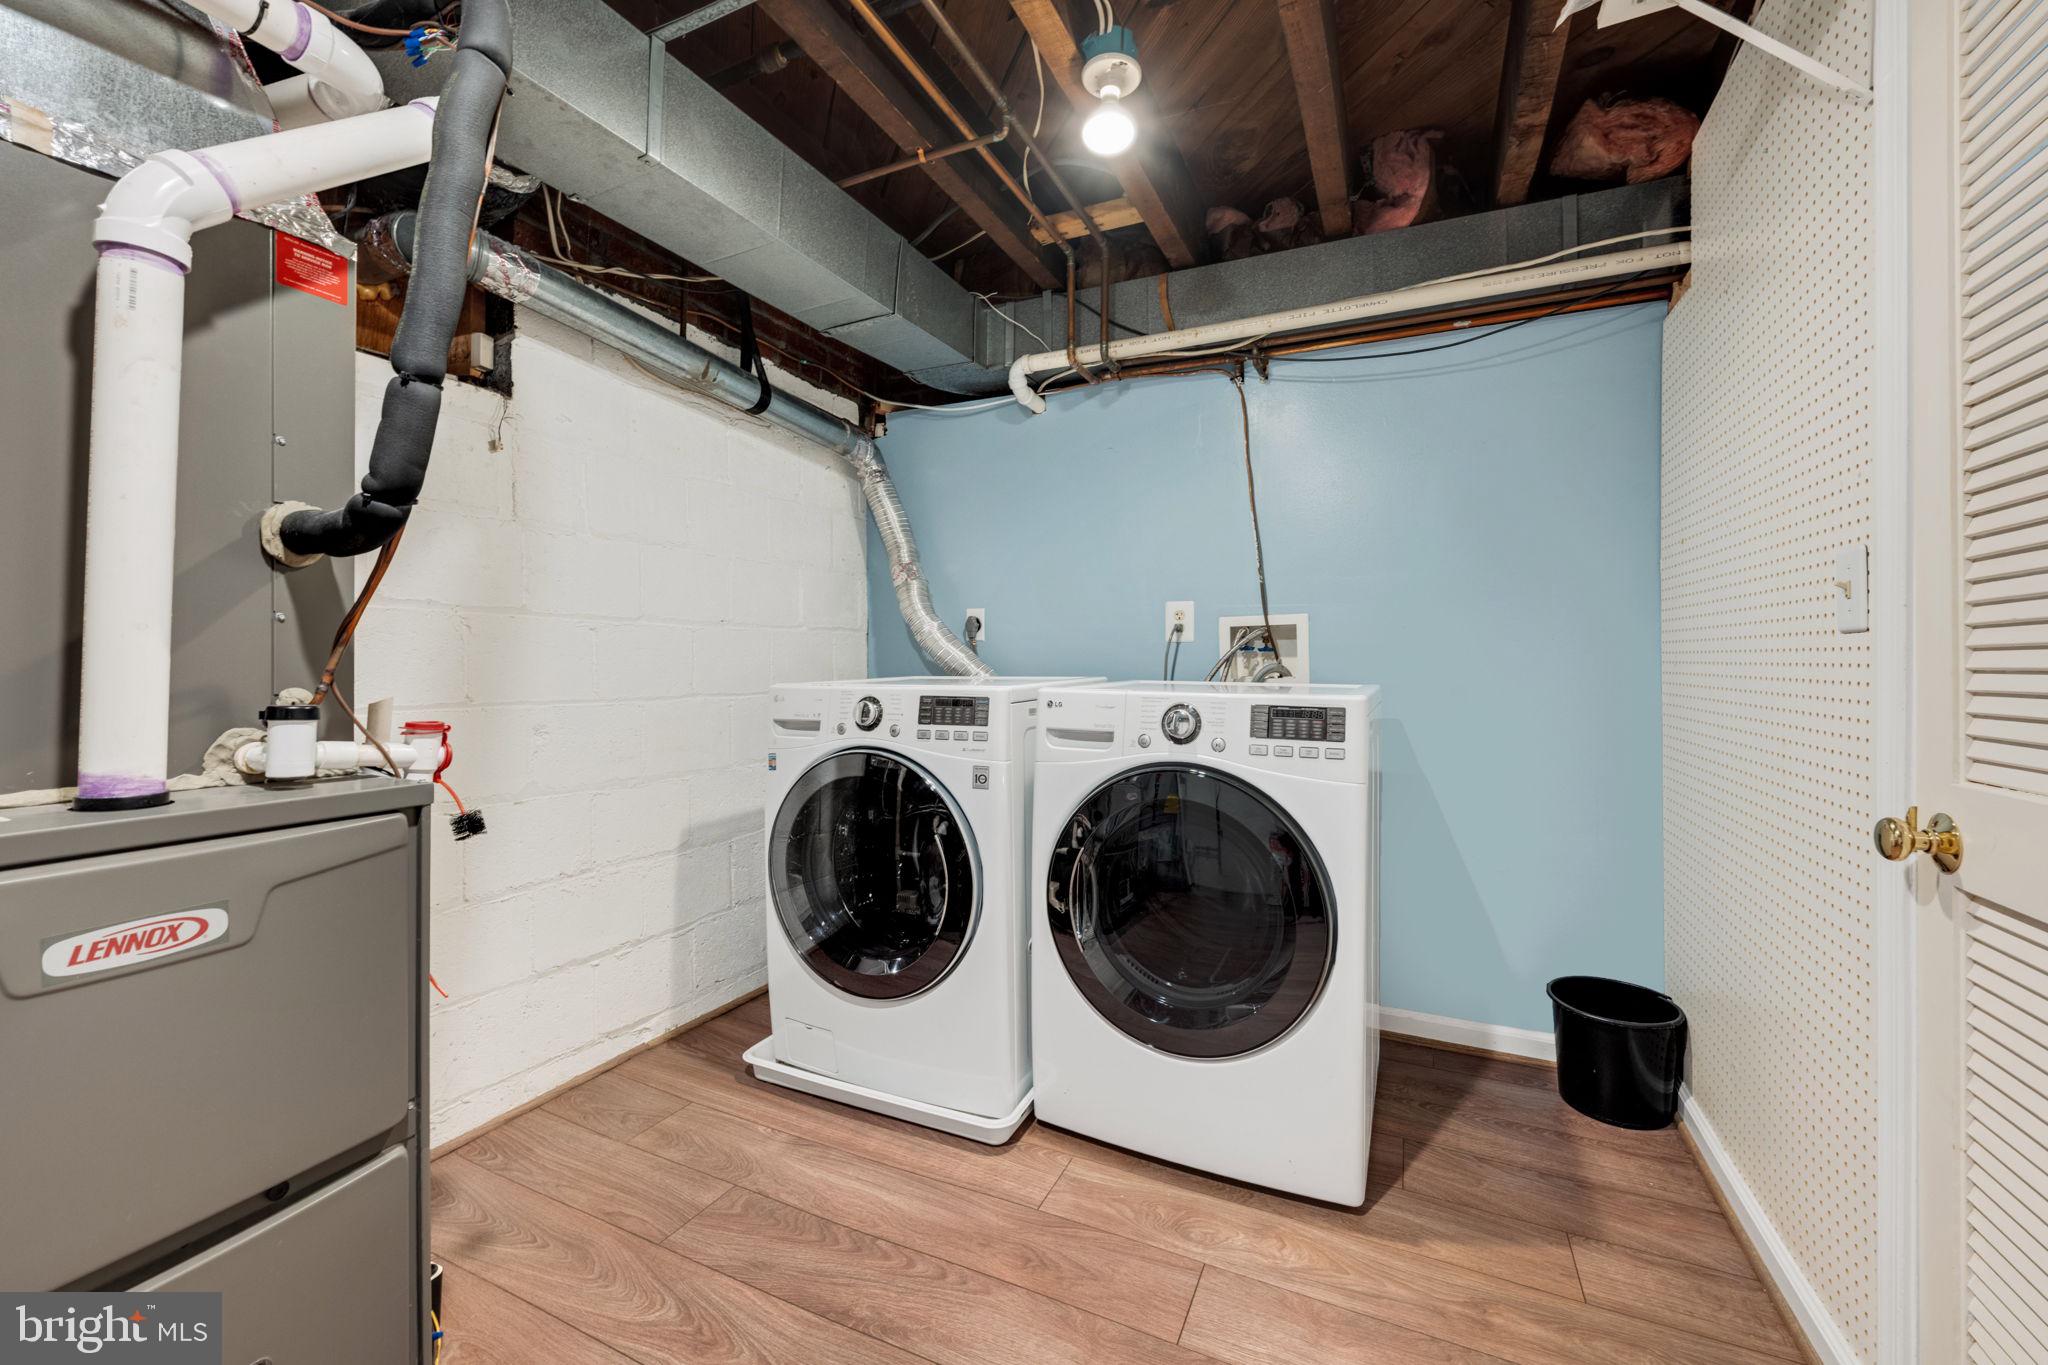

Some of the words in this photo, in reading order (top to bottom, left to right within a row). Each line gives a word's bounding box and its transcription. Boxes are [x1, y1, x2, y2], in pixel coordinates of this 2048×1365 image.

[1615, 255, 1644, 265] FOR
[1654, 249, 1682, 260] NOT
[1536, 260, 1607, 278] PRESSURE
[1321, 299, 1389, 314] CHARLOTTE
[66, 921, 184, 968] LENNOX
